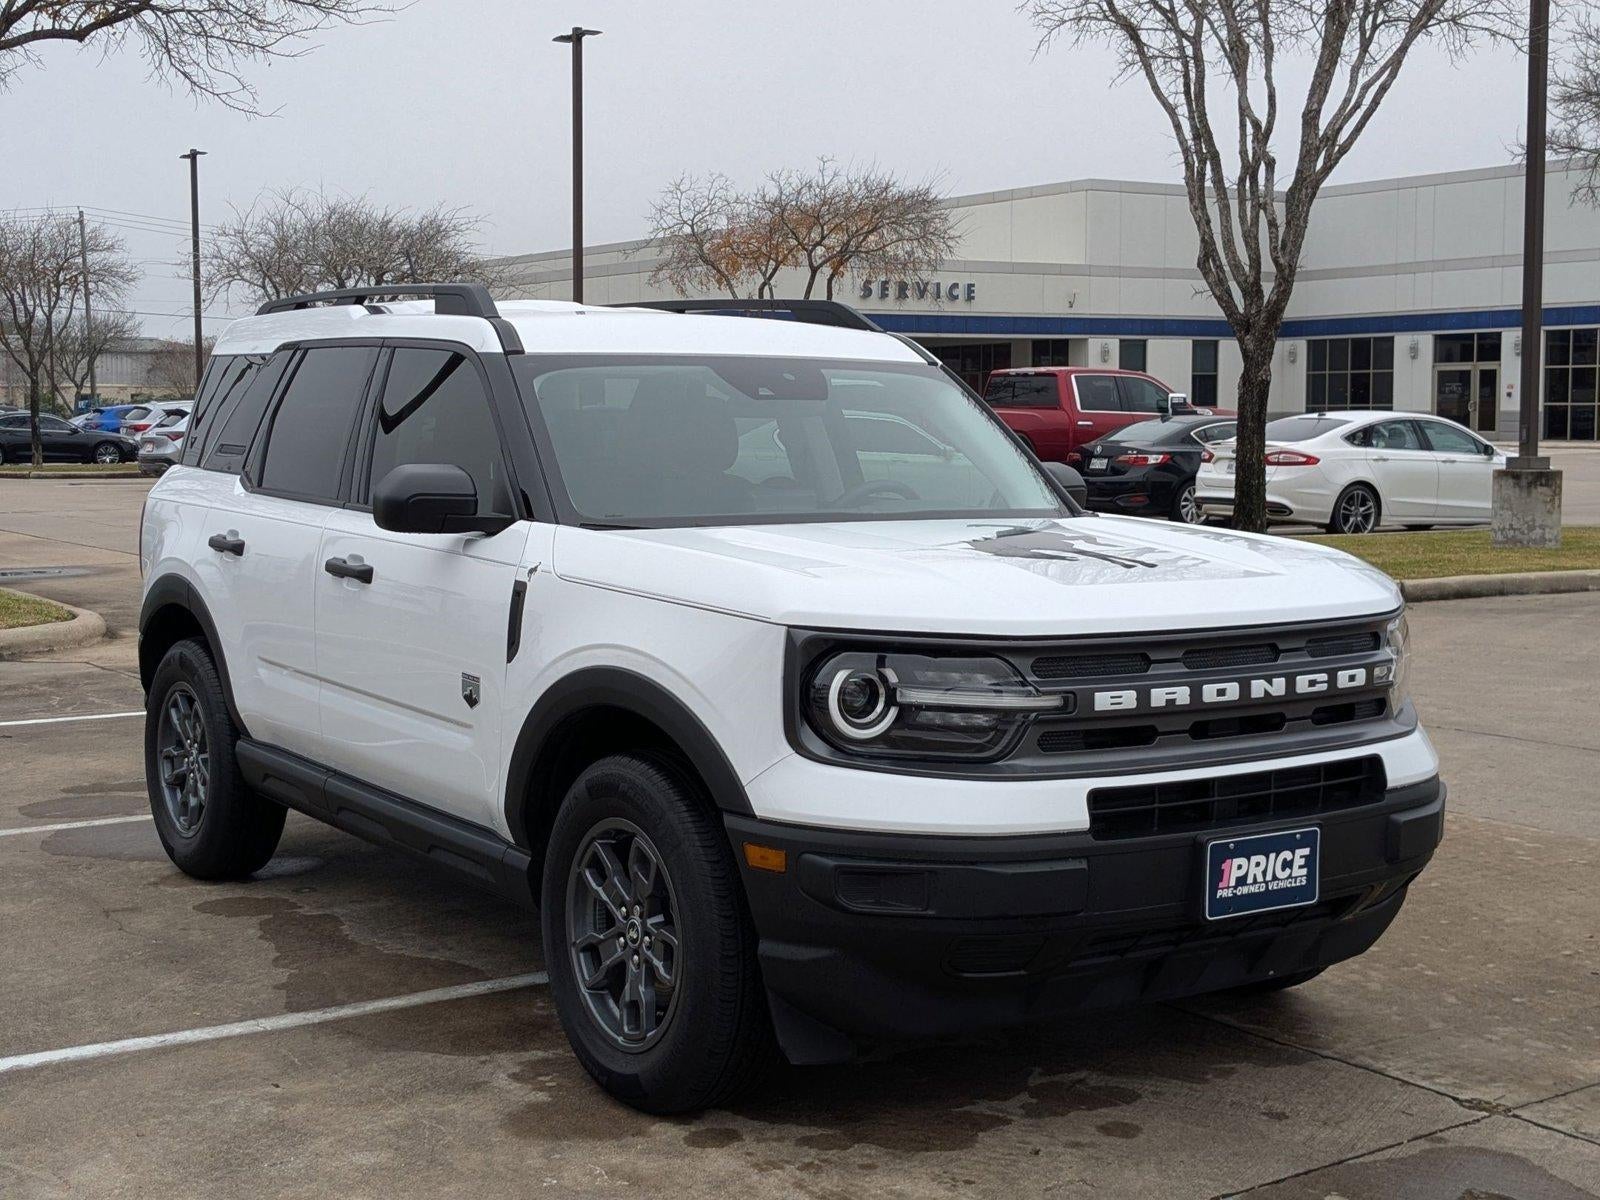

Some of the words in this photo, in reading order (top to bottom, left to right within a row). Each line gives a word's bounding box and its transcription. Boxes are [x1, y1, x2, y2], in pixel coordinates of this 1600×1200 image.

[860, 280, 976, 301] SERVICE
[1094, 668, 1367, 711] BRONCO
[1216, 883, 1266, 898] PRE-OWNED
[1268, 876, 1307, 890] VEHICLES
